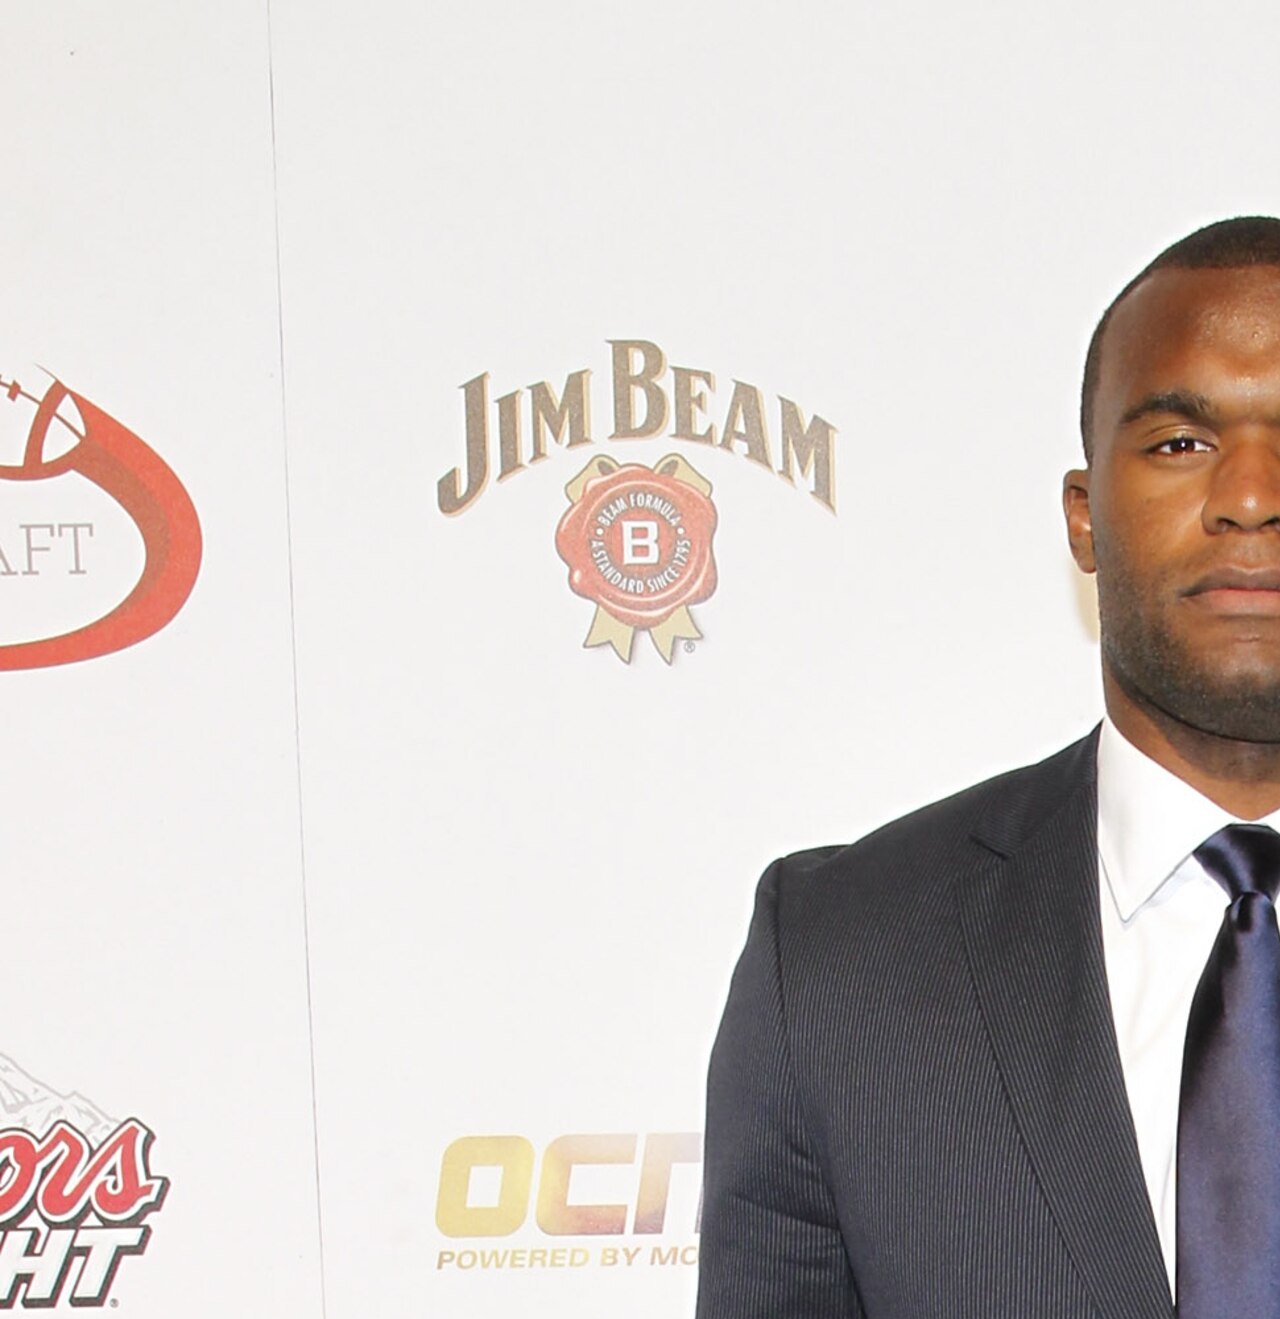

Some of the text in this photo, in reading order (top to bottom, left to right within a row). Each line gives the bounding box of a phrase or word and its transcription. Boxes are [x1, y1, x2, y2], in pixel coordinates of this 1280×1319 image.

[437, 339, 839, 518] JIM BEAM
[598, 493, 682, 527] BEAM FORMULA
[622, 520, 660, 565] B
[592, 550, 644, 594] STANDARD
[647, 564, 680, 593] SINCE
[672, 539, 691, 570] 1795
[436, 1248, 590, 1270] POWERED
[600, 1246, 642, 1266] BY
